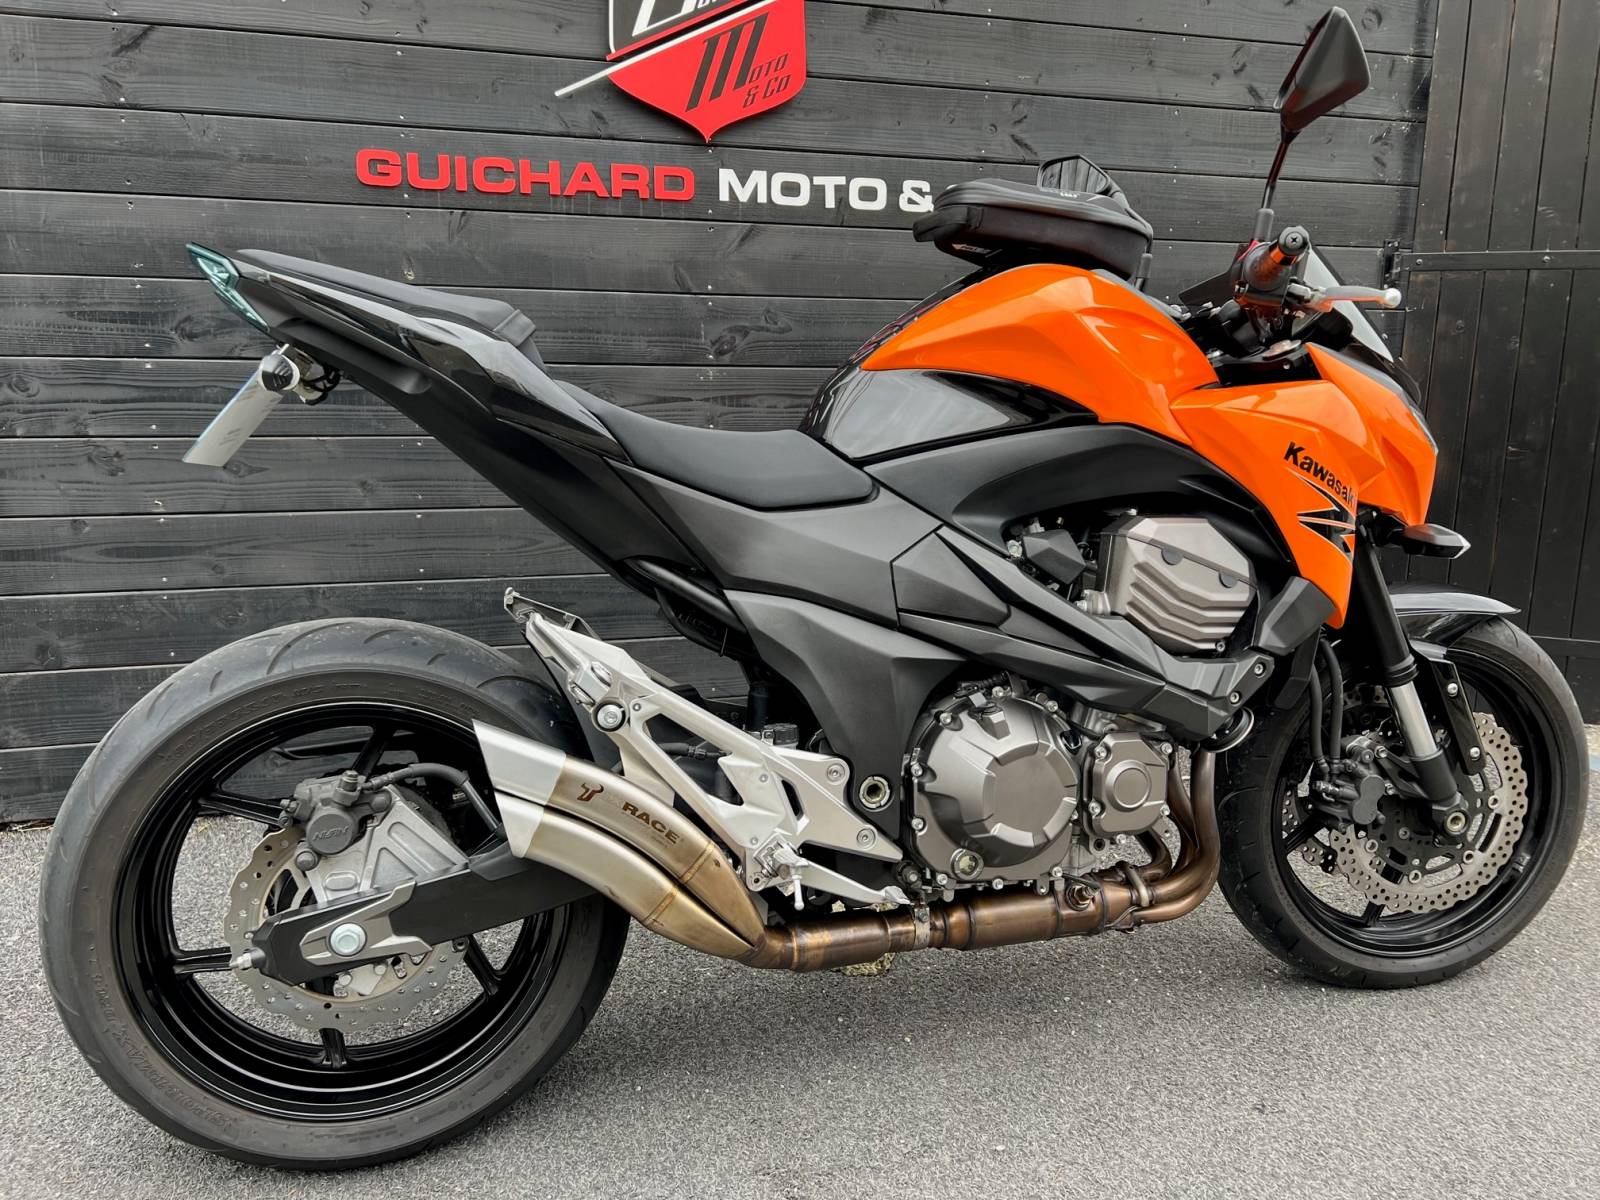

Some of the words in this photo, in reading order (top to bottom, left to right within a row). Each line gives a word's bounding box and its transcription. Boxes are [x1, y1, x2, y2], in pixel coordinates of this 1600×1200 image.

[356, 148, 695, 201] GUICHARD
[718, 168, 887, 210] MOTO
[899, 179, 935, 213] &
[1283, 441, 1355, 507] Kawasak
